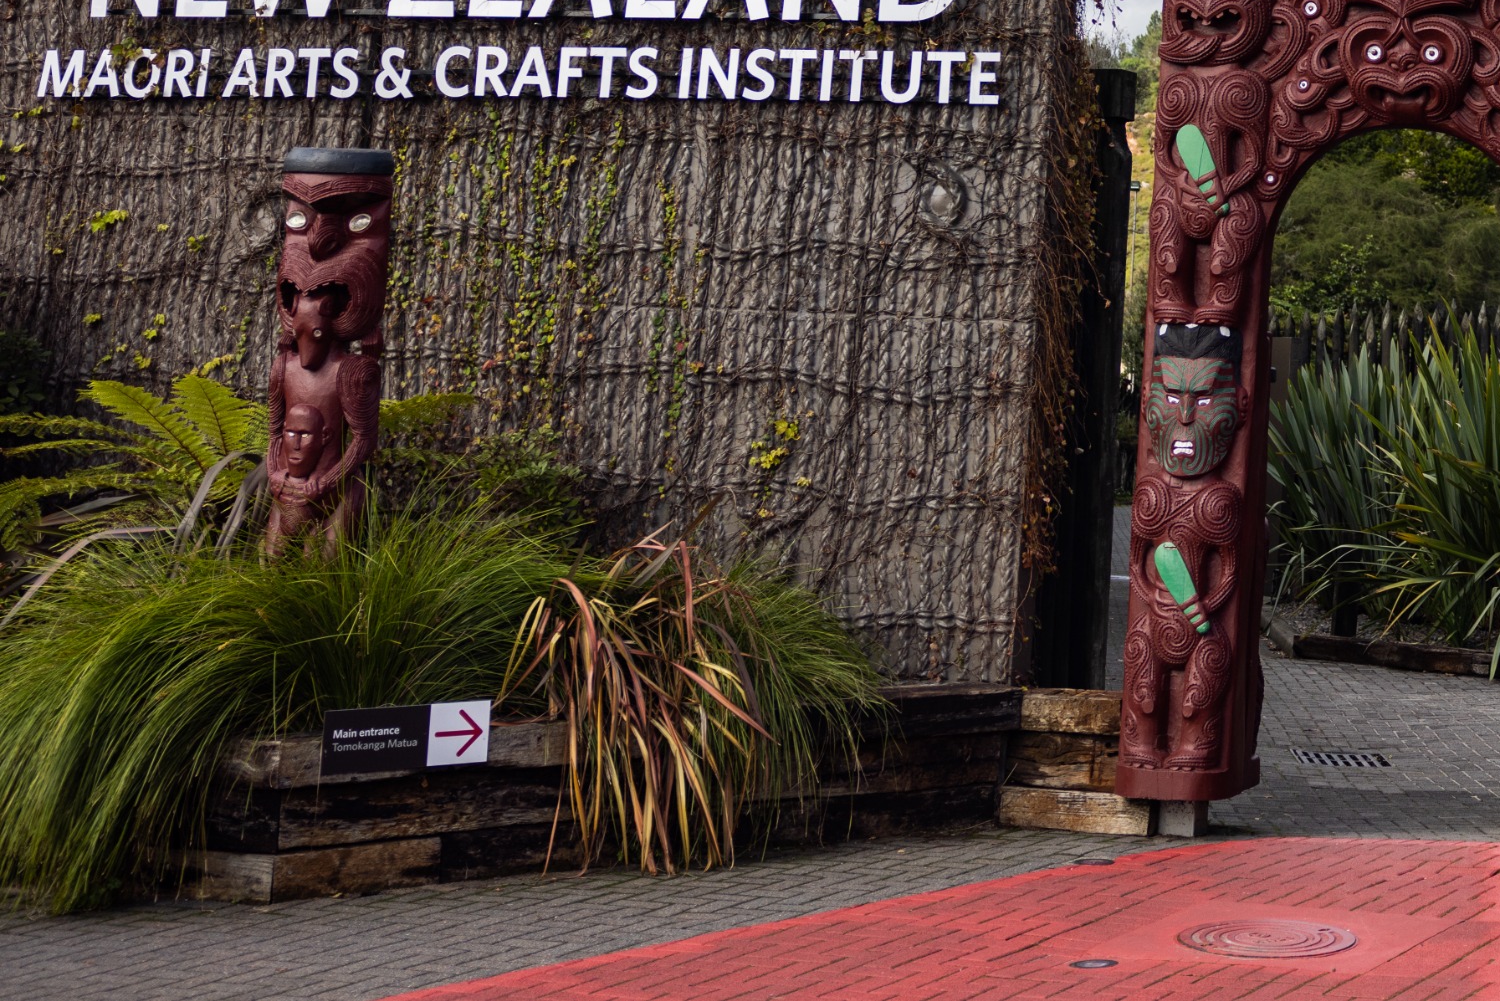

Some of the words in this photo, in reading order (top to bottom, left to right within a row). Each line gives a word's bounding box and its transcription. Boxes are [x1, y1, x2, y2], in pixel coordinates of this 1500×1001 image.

[37, 49, 209, 99] MAORI
[222, 47, 359, 98] ARTS
[374, 47, 413, 99] &
[434, 45, 659, 98] CRAFTS
[677, 48, 1000, 105] INSTITUTE
[333, 729, 357, 739] Main
[359, 727, 400, 737] entrance
[332, 740, 385, 752] Tomokanga
[388, 739, 418, 749] Matua
